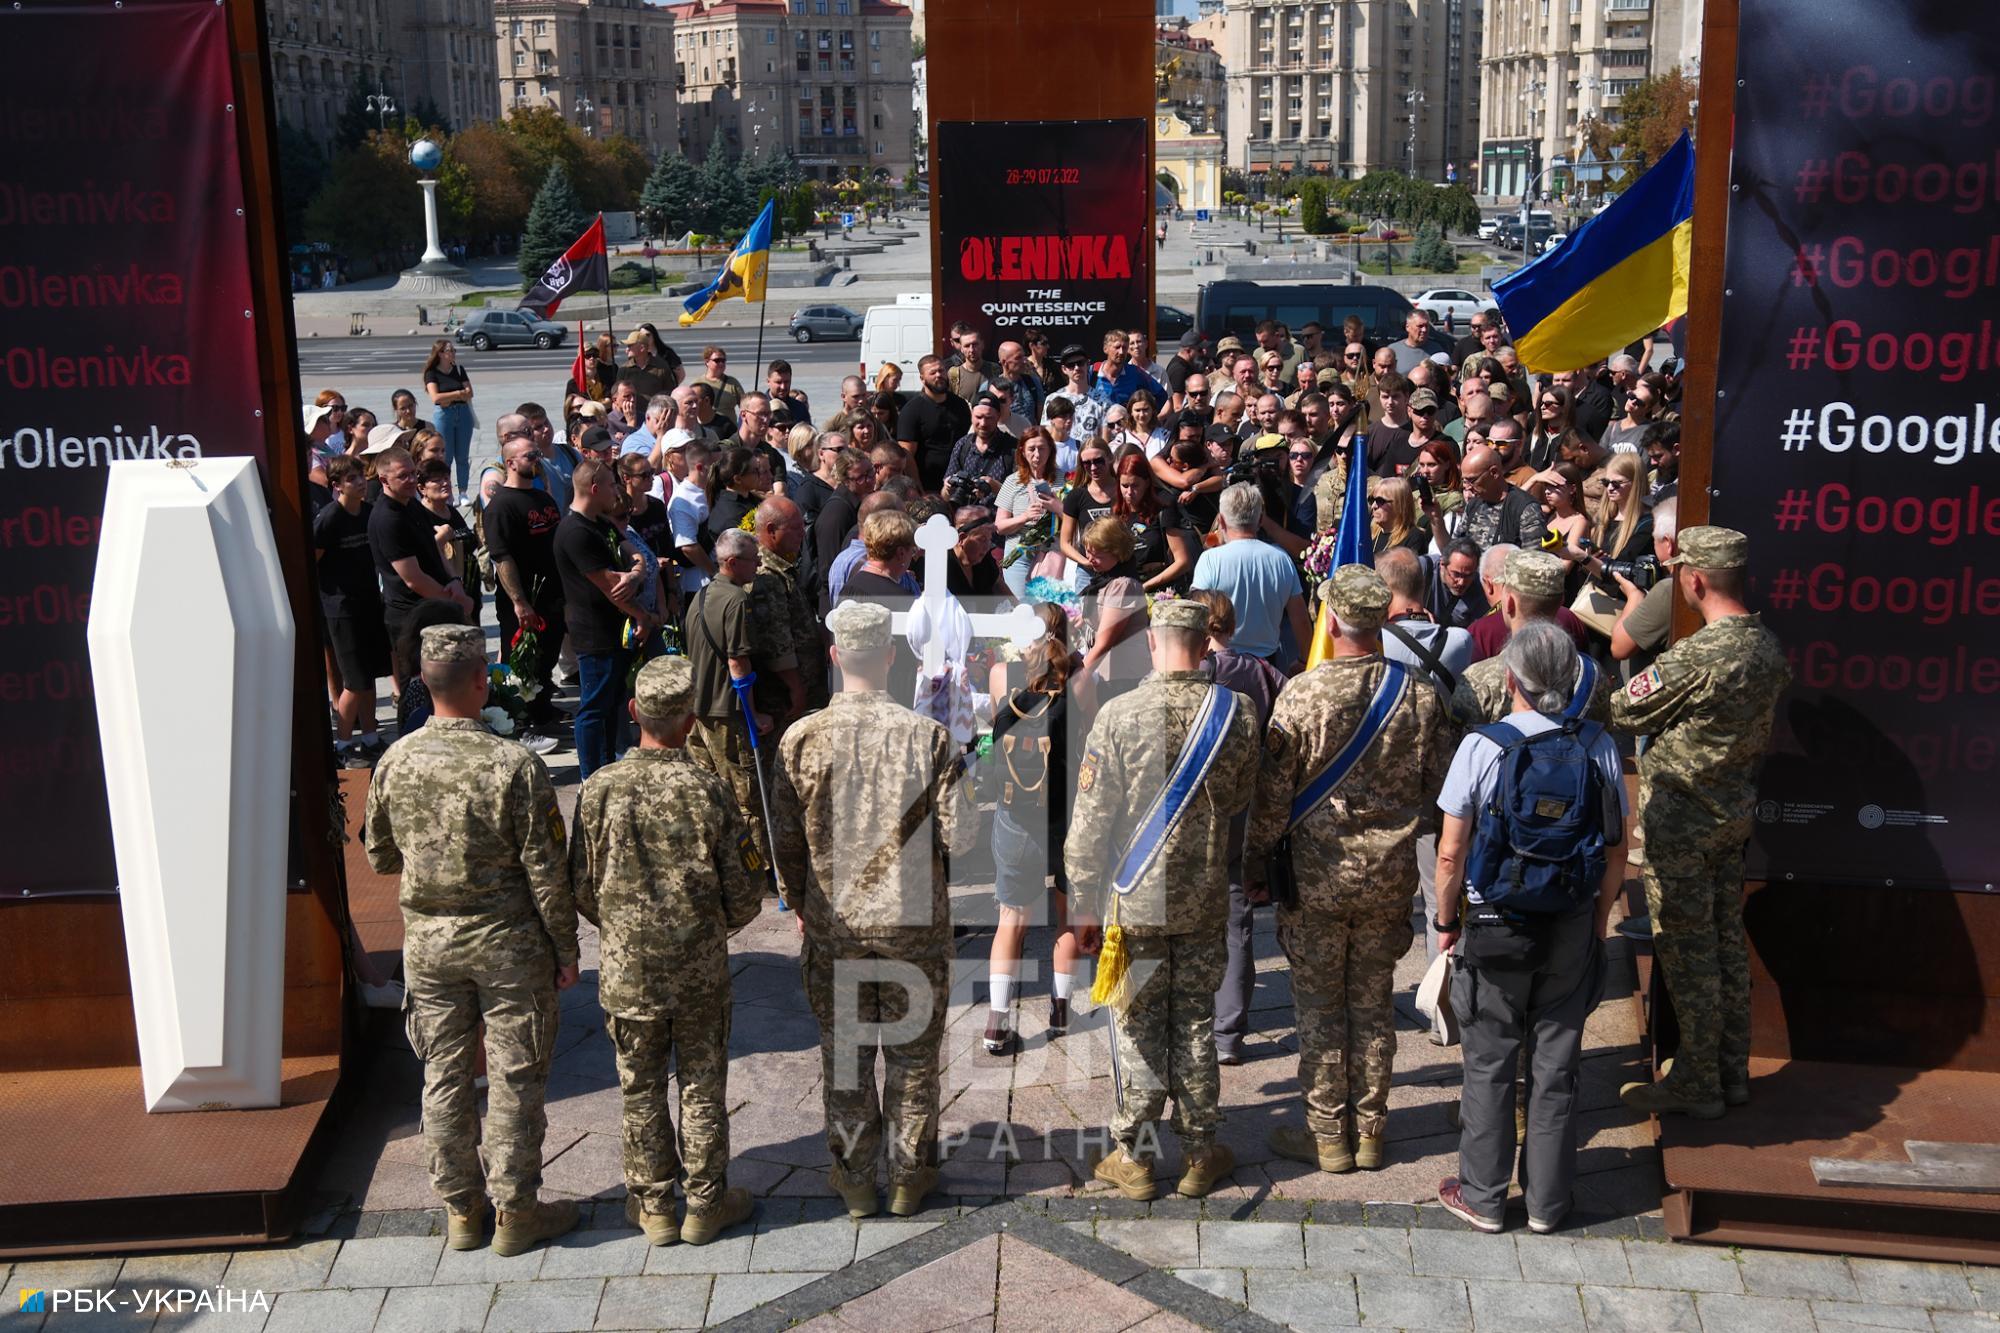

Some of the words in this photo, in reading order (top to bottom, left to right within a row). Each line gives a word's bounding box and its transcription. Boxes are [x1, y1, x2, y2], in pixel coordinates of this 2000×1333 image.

[960, 234, 1132, 281] OLENIVKA
[981, 301, 1106, 316] QUINTESSENCE
[1026, 288, 1062, 299] THE
[995, 316, 1019, 326] OF
[1021, 315, 1093, 326] CRUELTY
[1786, 319, 2000, 382] #Googl
[1769, 561, 2000, 625] #Google
